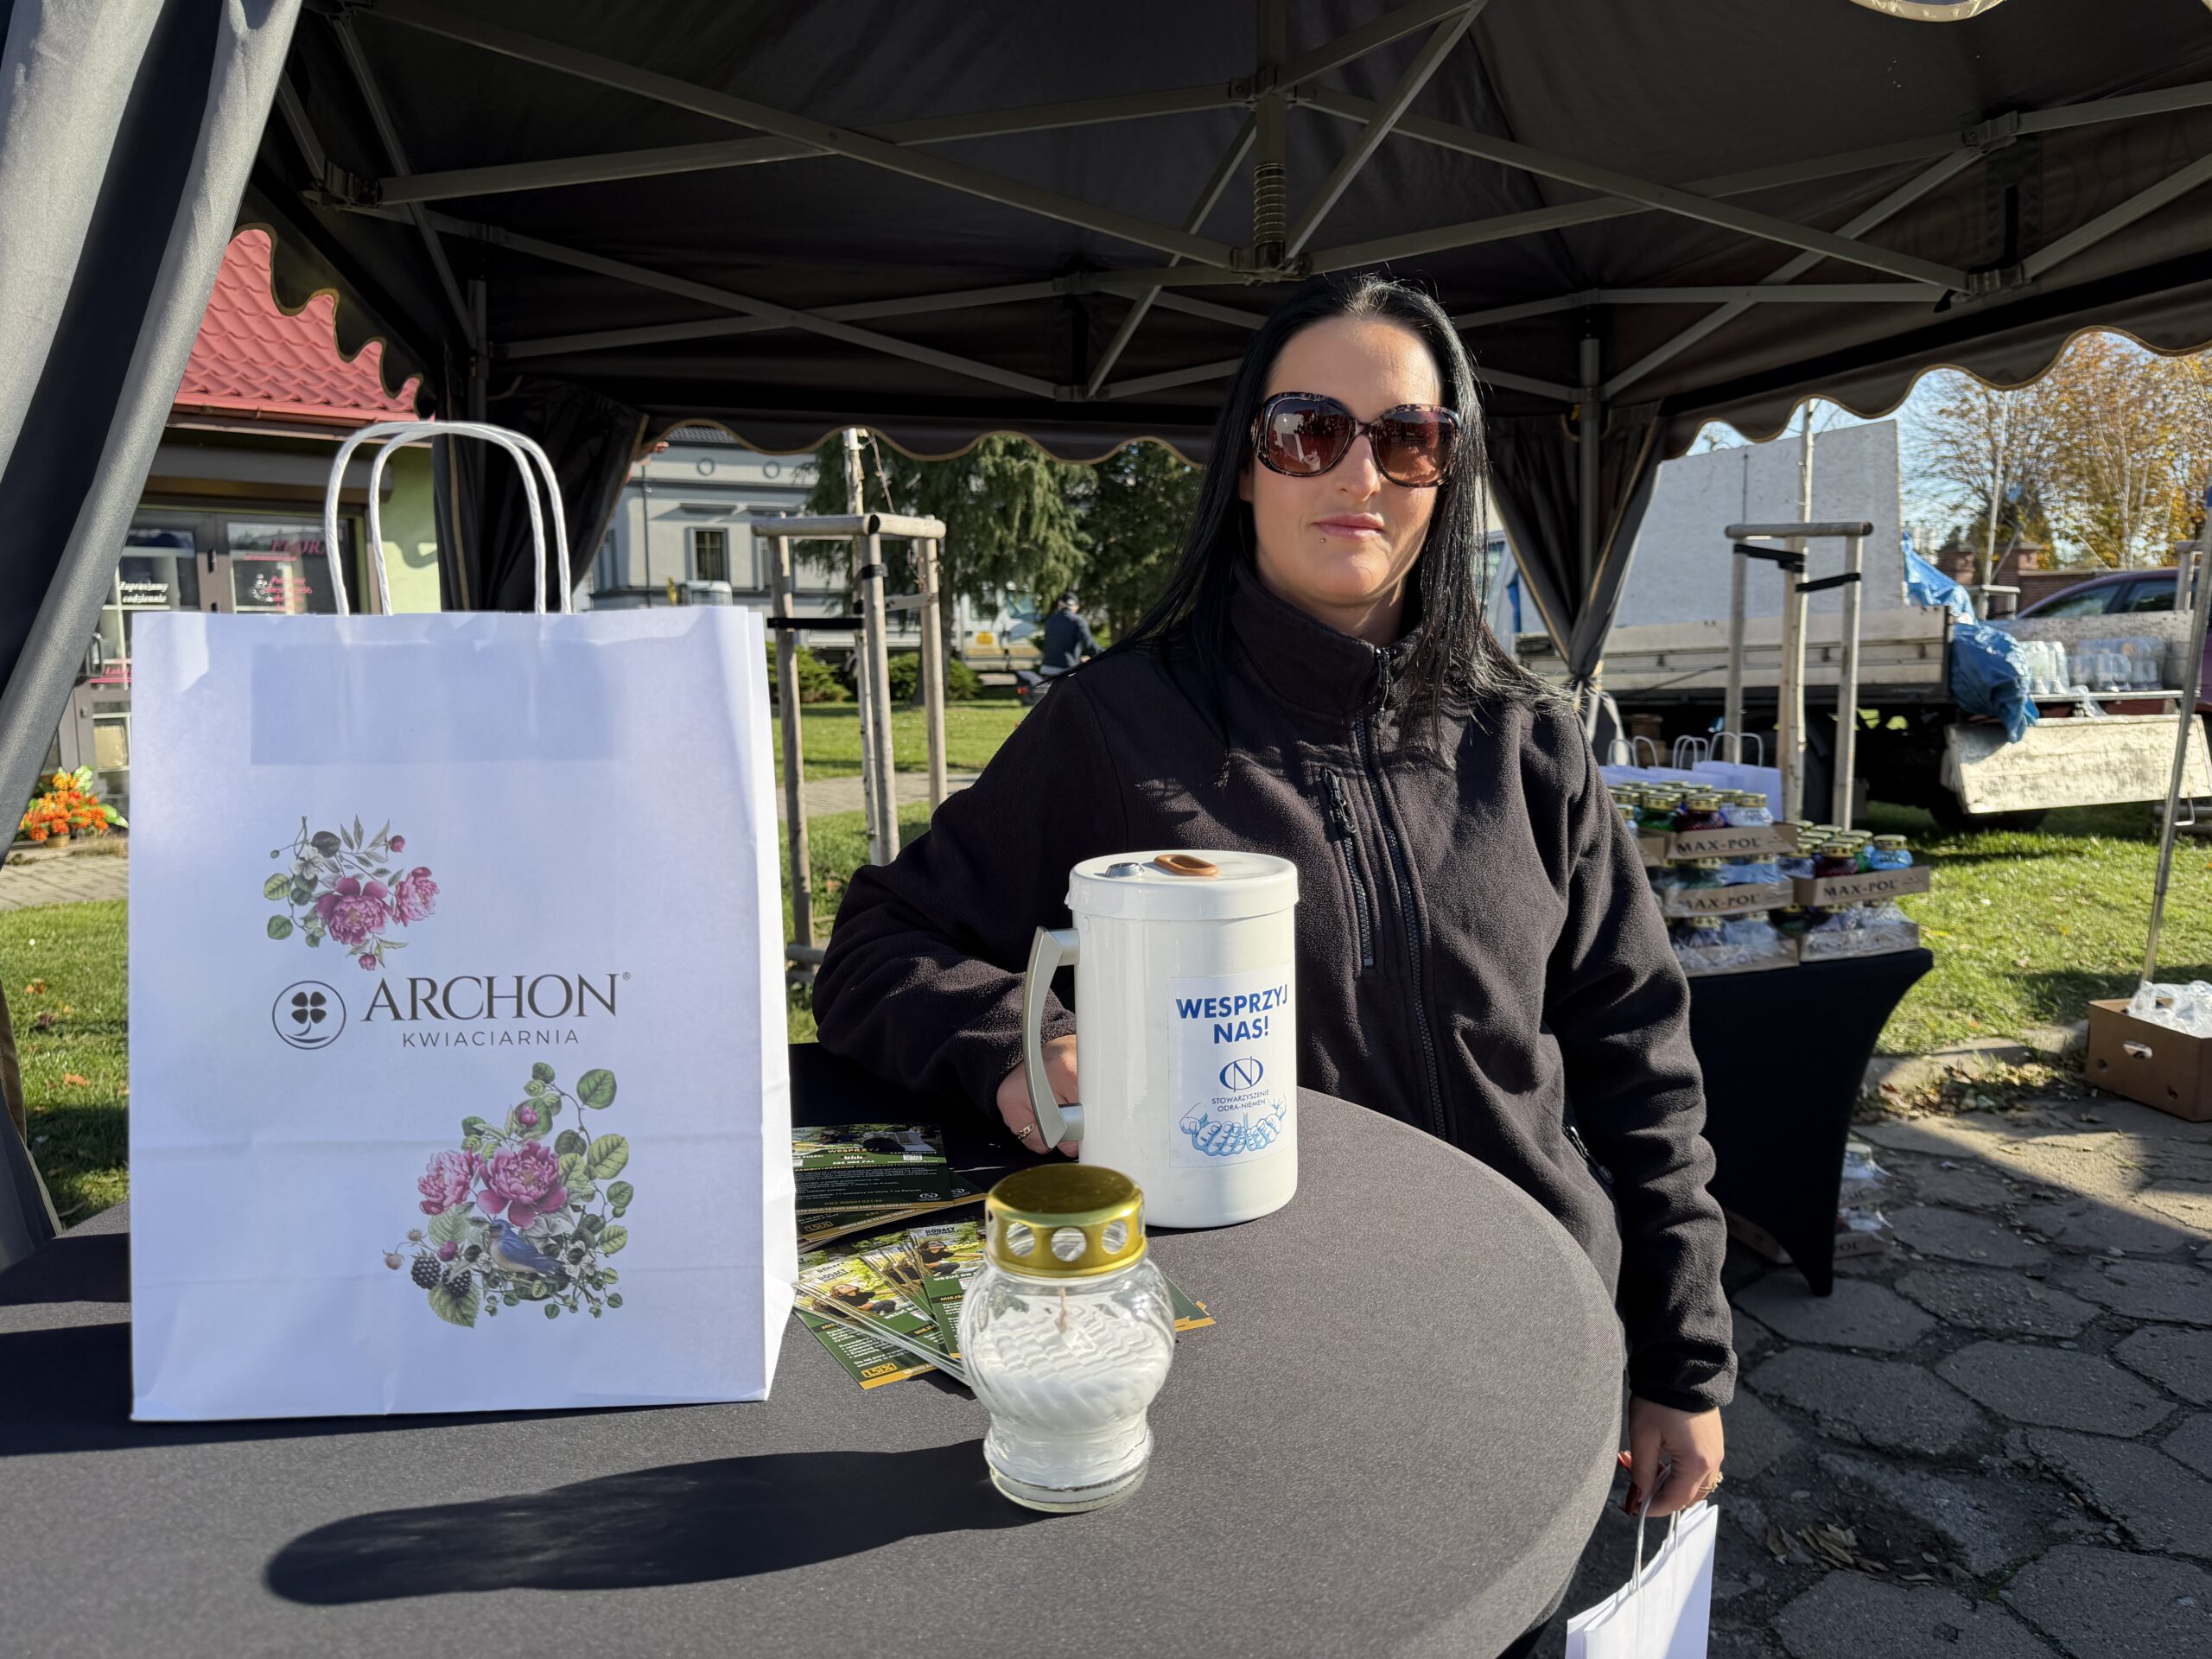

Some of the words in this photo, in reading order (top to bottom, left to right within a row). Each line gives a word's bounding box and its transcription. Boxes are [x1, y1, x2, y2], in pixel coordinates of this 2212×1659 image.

[1676, 837, 1761, 853] MAX-POL
[1824, 879, 1897, 898] MAX-POL
[1176, 983, 1287, 1020] WESPRZYJ
[403, 1029, 580, 1048] KWIACIARNIA
[1214, 1015, 1269, 1045] NAS!
[1211, 1089, 1270, 1105] STOWARZYSZENIE
[1217, 1098, 1267, 1112] ODRA-NIEMEN
